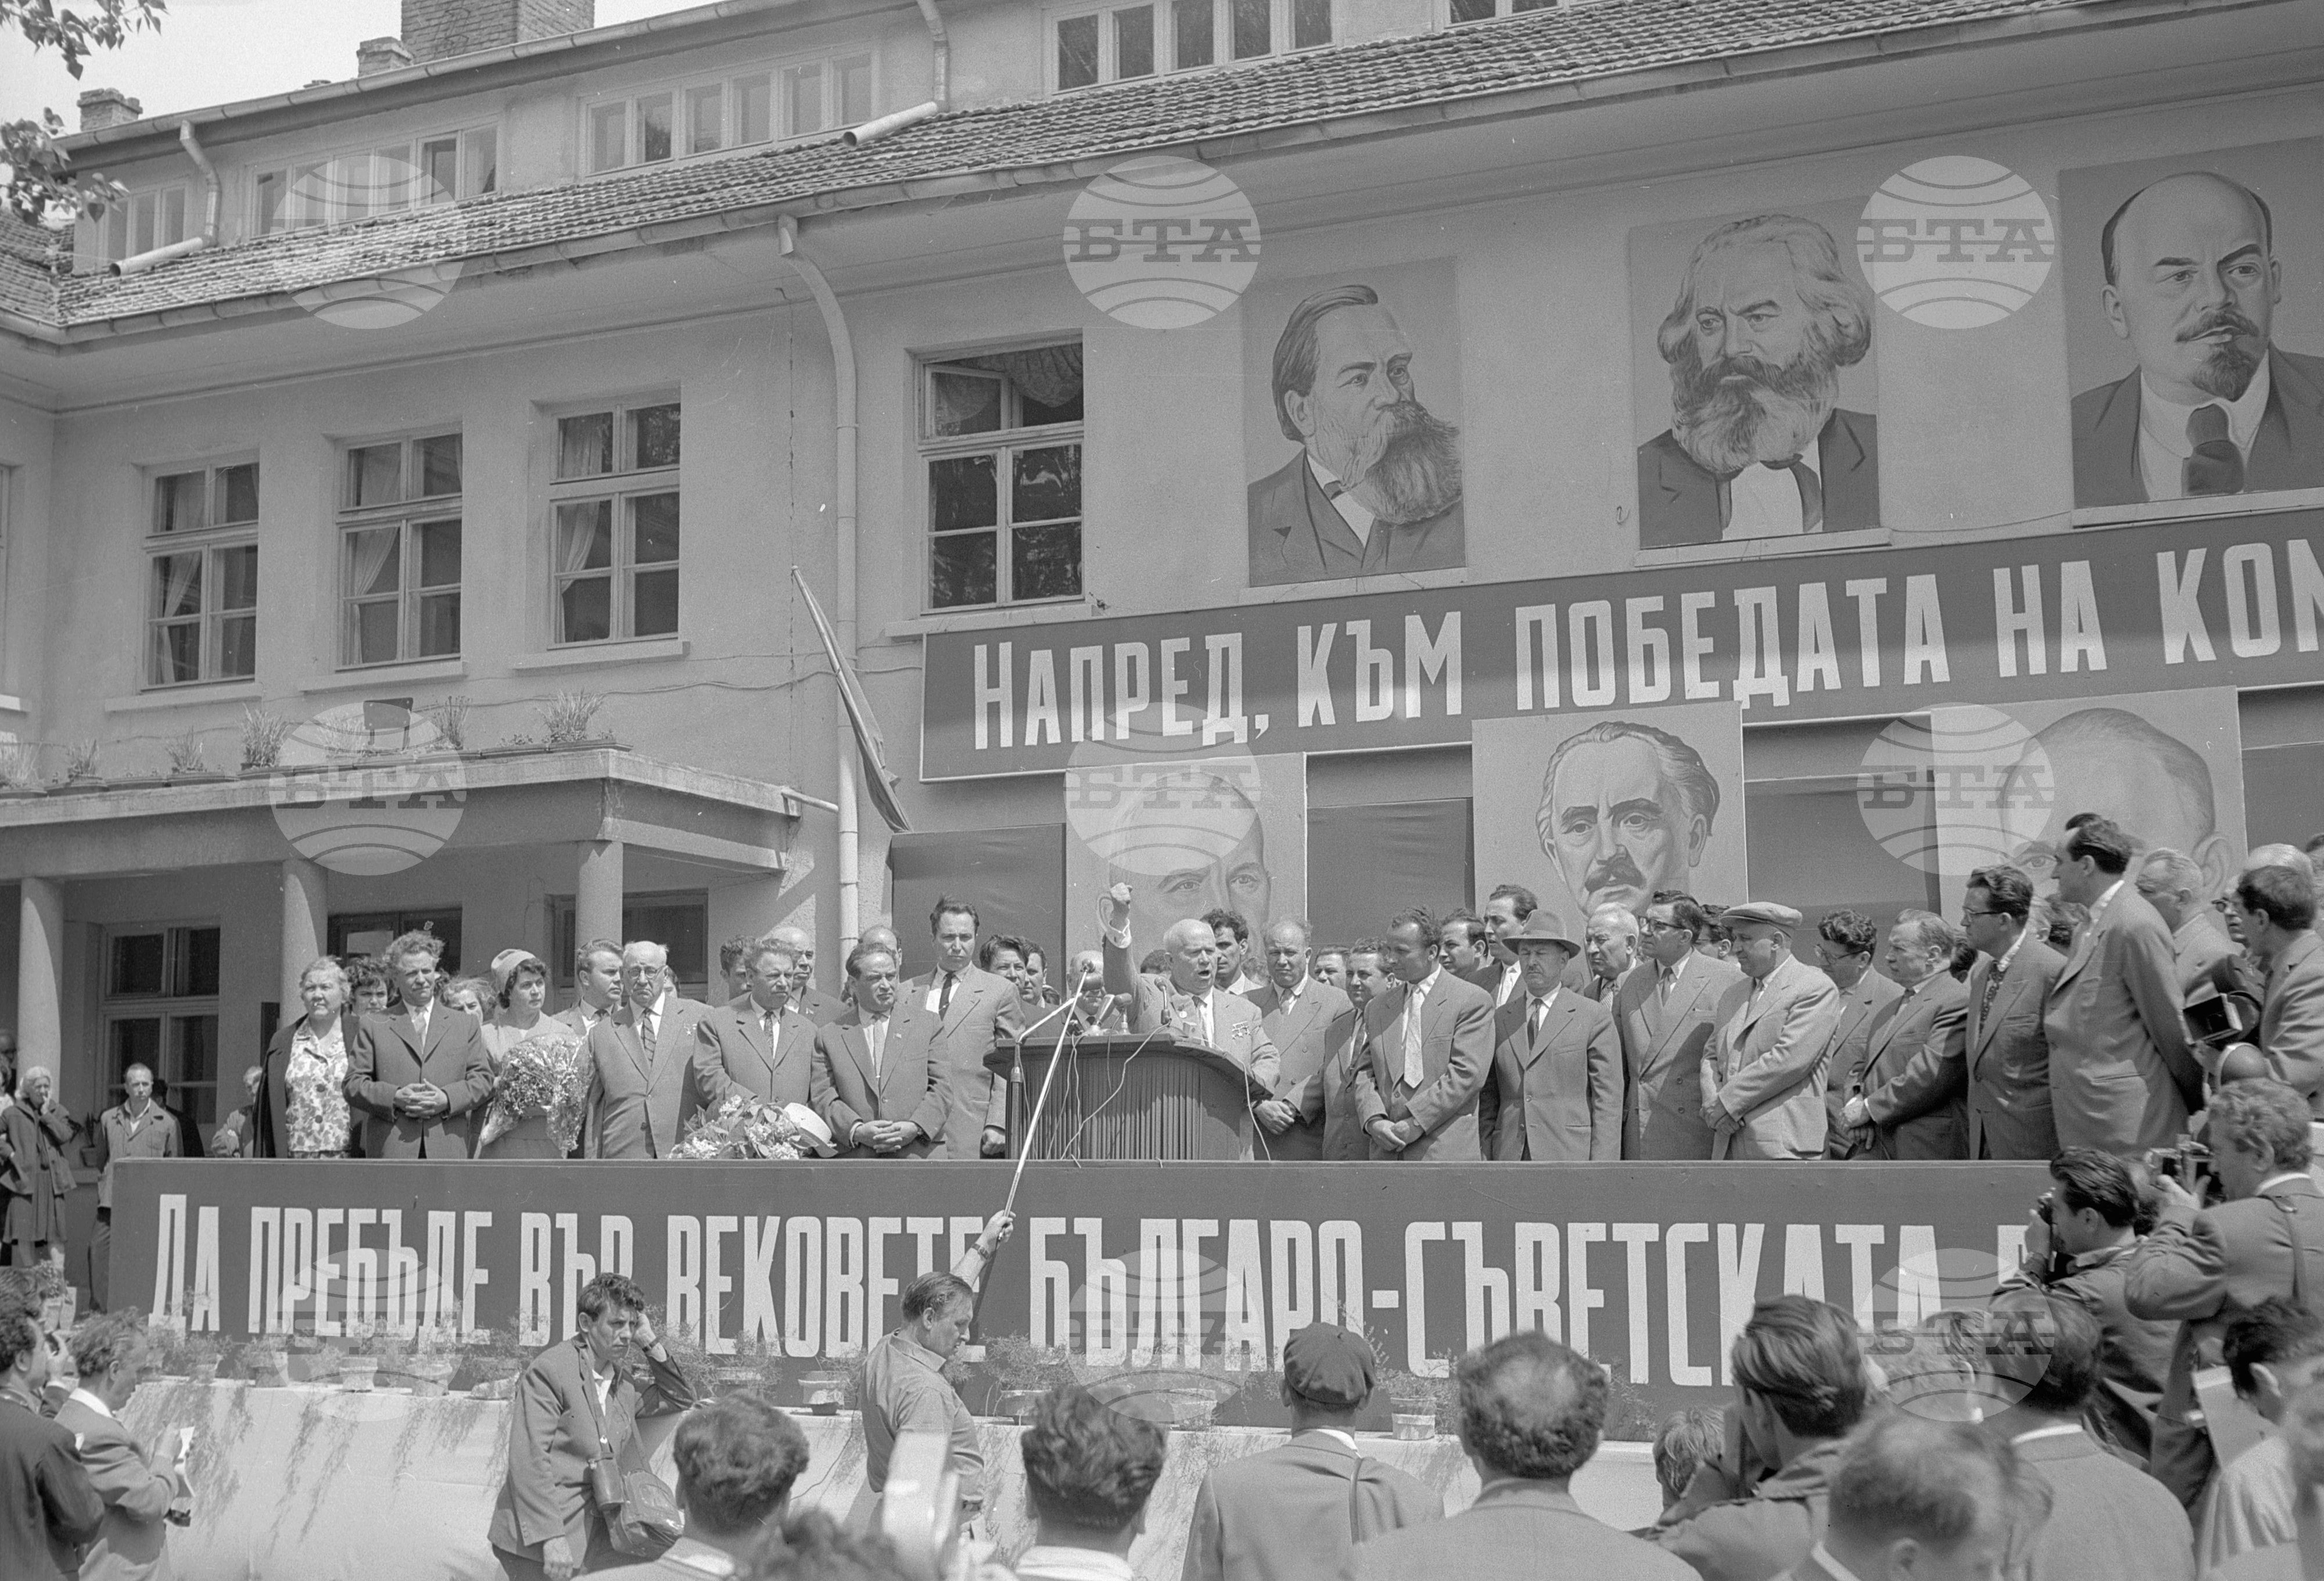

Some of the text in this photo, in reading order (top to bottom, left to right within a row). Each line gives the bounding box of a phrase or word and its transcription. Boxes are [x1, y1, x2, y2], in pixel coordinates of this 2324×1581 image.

[974, 632, 1269, 750] НАПРЕД,
[1297, 610, 1462, 728] КЪМ
[1515, 573, 1951, 710] ПОБЕДАТА
[1992, 559, 2108, 678] НА
[148, 1194, 220, 1349] ДА
